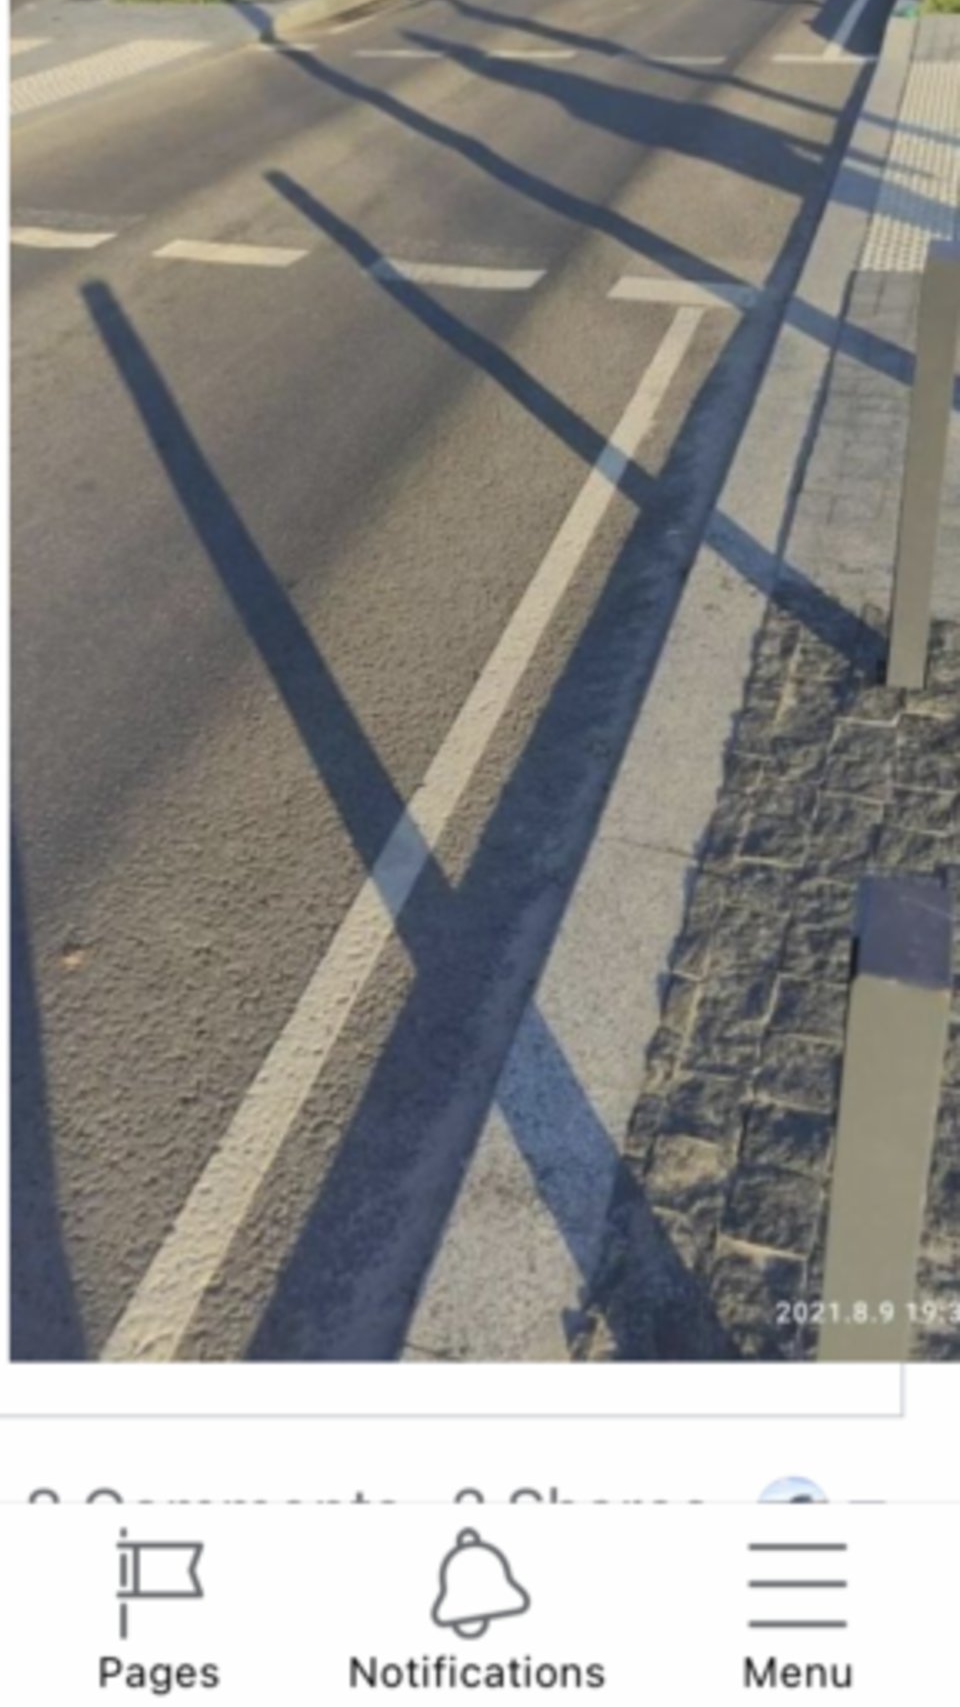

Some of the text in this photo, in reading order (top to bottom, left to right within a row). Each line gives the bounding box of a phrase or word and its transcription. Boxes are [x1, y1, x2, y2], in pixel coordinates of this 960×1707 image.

[99, 1655, 220, 1696] Pages
[349, 1654, 606, 1689] Notifications
[743, 1655, 853, 1689] Menu
